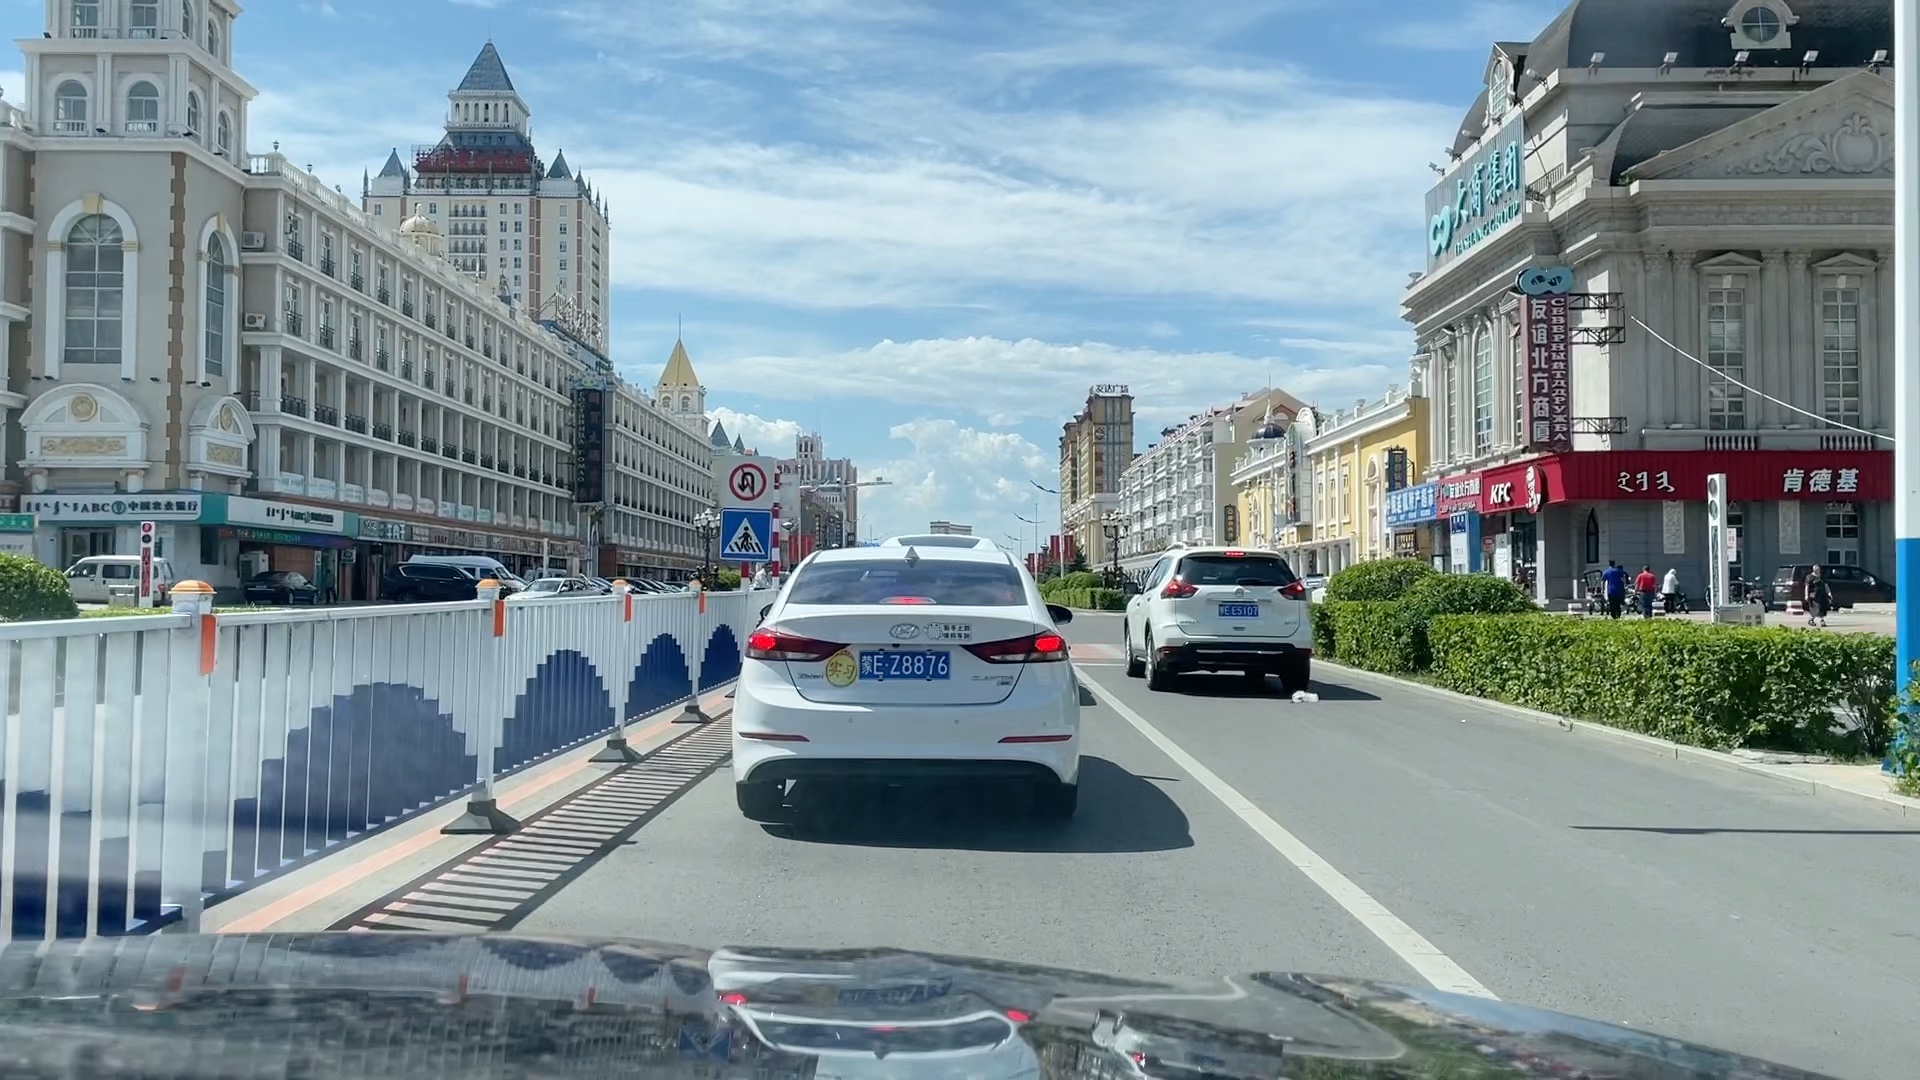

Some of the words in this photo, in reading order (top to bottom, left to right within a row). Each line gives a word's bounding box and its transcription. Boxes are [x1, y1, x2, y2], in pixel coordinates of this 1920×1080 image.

[1454, 140, 1519, 229] 大商集团
[1531, 298, 1550, 443] 友谊北方商厦
[1783, 467, 1860, 493] 肯德基
[1490, 481, 1511, 504] KFC
[80, 502, 111, 514] ABC
[127, 500, 198, 512] 中国农业银行
[828, 660, 855, 680] 实习
[861, 655, 948, 676] 蒙E·Z8876
